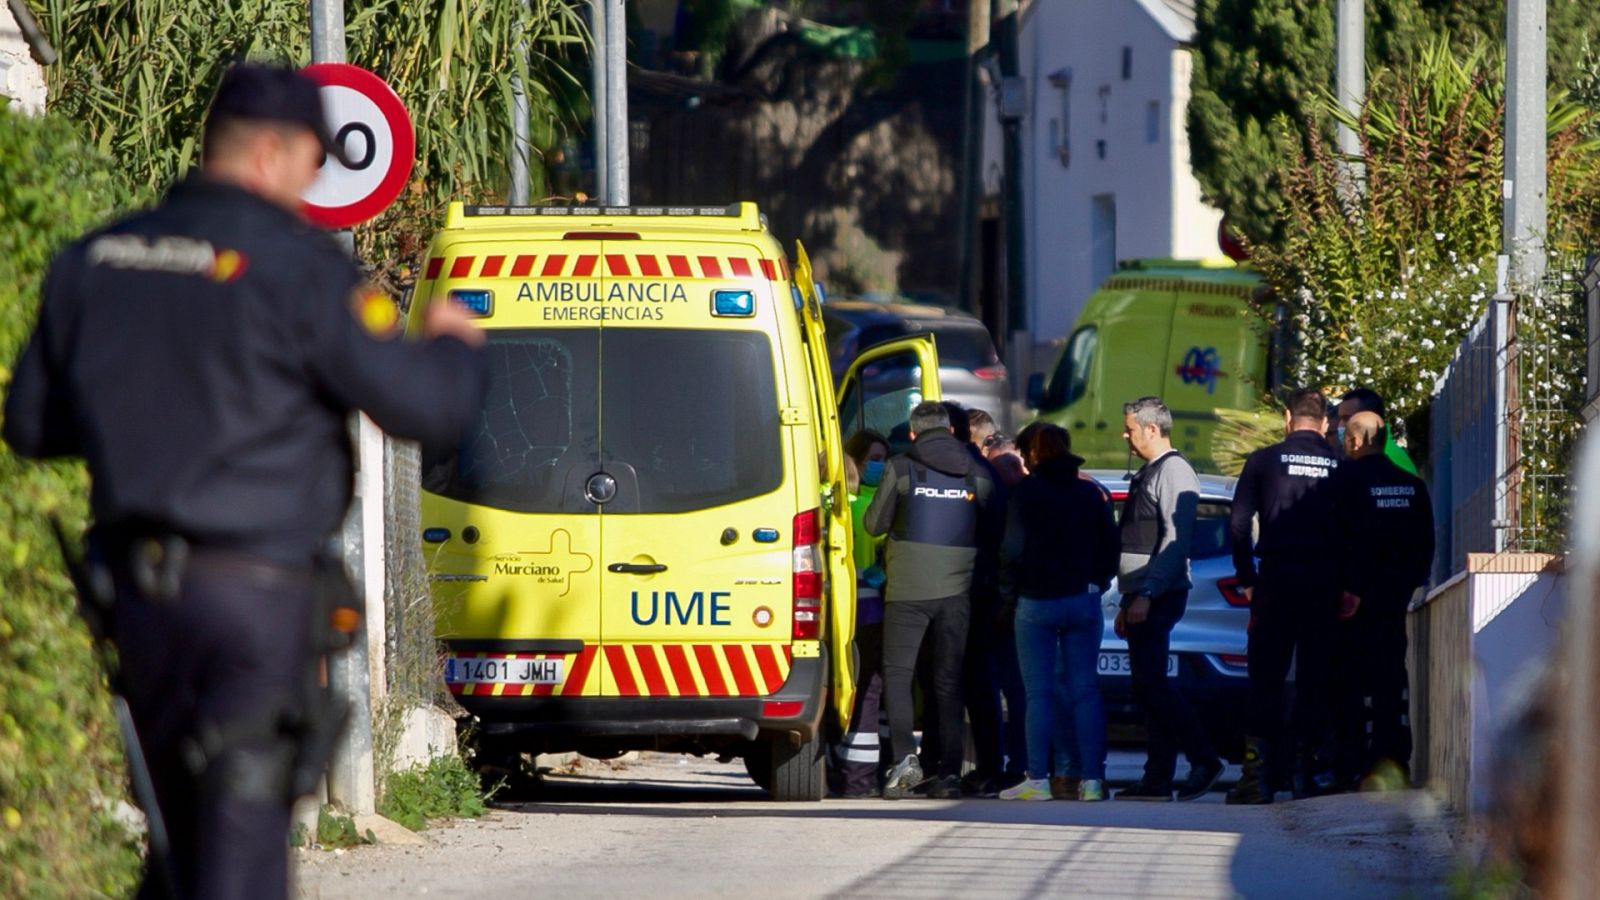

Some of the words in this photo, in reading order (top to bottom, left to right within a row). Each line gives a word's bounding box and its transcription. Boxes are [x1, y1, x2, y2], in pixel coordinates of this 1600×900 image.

[516, 282, 688, 303] AMBULANCIA
[543, 306, 664, 321] EMERGENCIAS
[1281, 454, 1338, 468] BOMBEROS
[1288, 464, 1329, 477] MURCIA
[915, 487, 968, 498] POLICIA
[1377, 498, 1410, 508] MURCIA
[494, 562, 560, 576] Murciano
[631, 591, 731, 625] UME
[1099, 655, 1131, 672] 033
[463, 662, 508, 680] 1401
[520, 662, 556, 681] JMH
